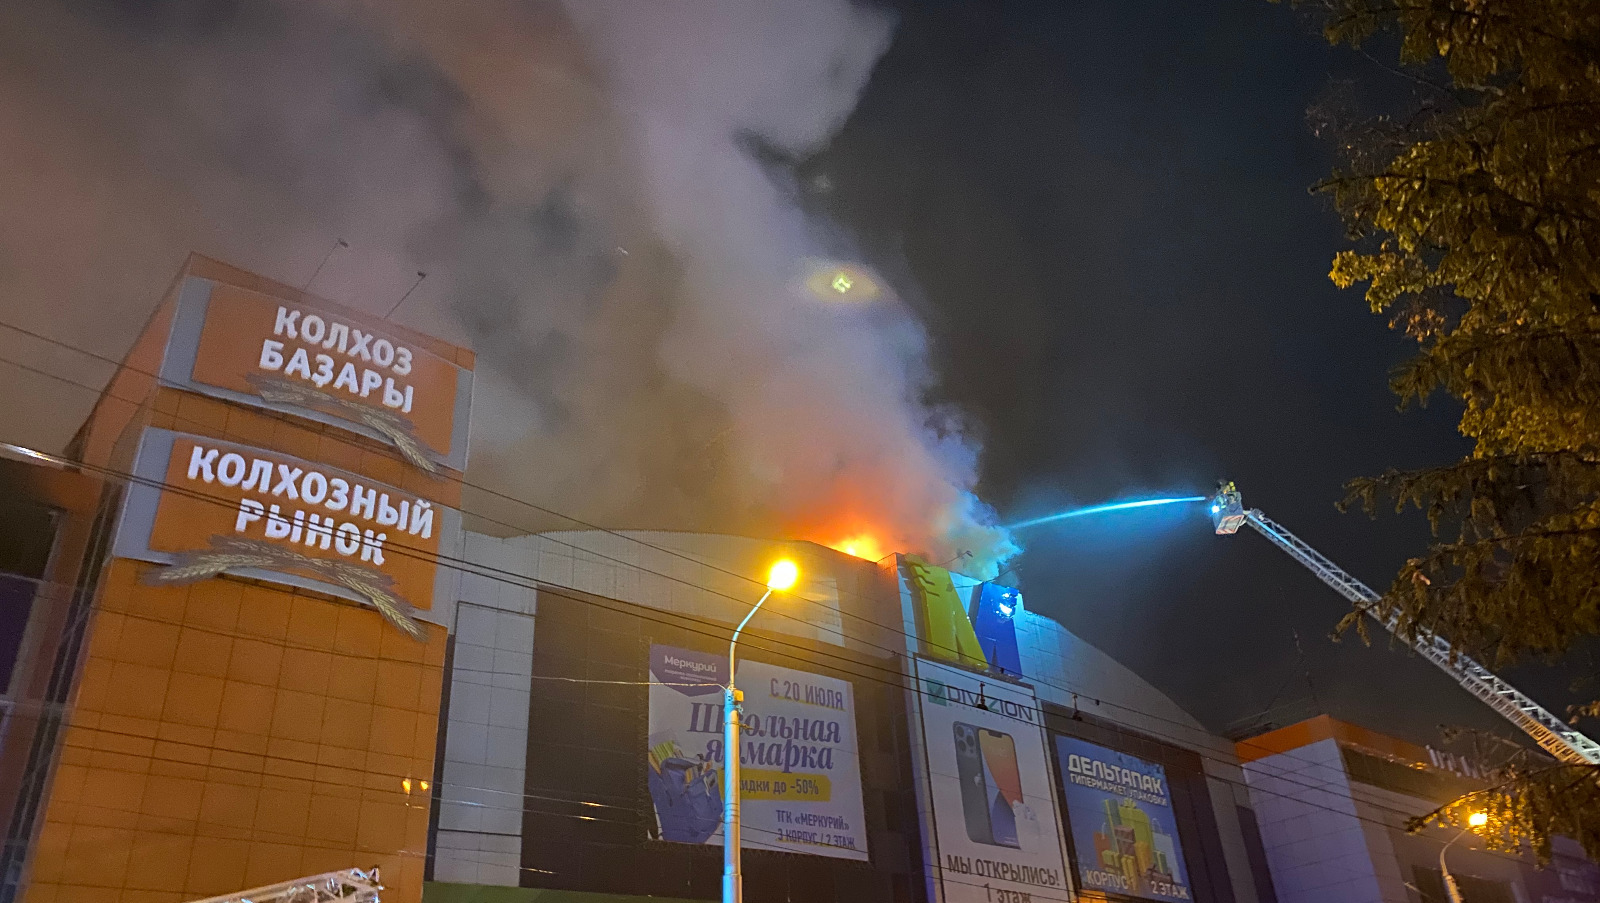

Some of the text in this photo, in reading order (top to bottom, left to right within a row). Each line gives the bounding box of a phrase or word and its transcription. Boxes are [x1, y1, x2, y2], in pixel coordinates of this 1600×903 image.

[274, 306, 412, 375] КОЛХОЗ
[187, 446, 434, 539] КОЛХОЗНЫЙ
[235, 498, 387, 565] РЫНОК
[664, 655, 717, 673] Меркурий
[770, 678, 844, 711] С 20 ИЮЛЯ
[687, 702, 842, 743] Шольная
[704, 739, 834, 773] ямарка
[773, 780, 787, 795] до
[790, 779, 819, 795] -50%
[1068, 754, 1164, 796] ДЕЛЬТАПАК
[1070, 773, 1126, 796] ГИПЕРМАРКЕТ
[776, 809, 850, 831] ТГК «МЕРКУРИЙ»
[778, 828, 784, 841] 3
[786, 829, 818, 846] КОРПУС
[834, 835, 856, 850] ЭТАЖ
[947, 855, 1060, 887] МЫ ОТКРЫЛИСЬ!
[1086, 870, 1129, 891] КОРПУС
[984, 883, 991, 903] 1
[1151, 881, 1190, 900] 2 ЭТАЖ
